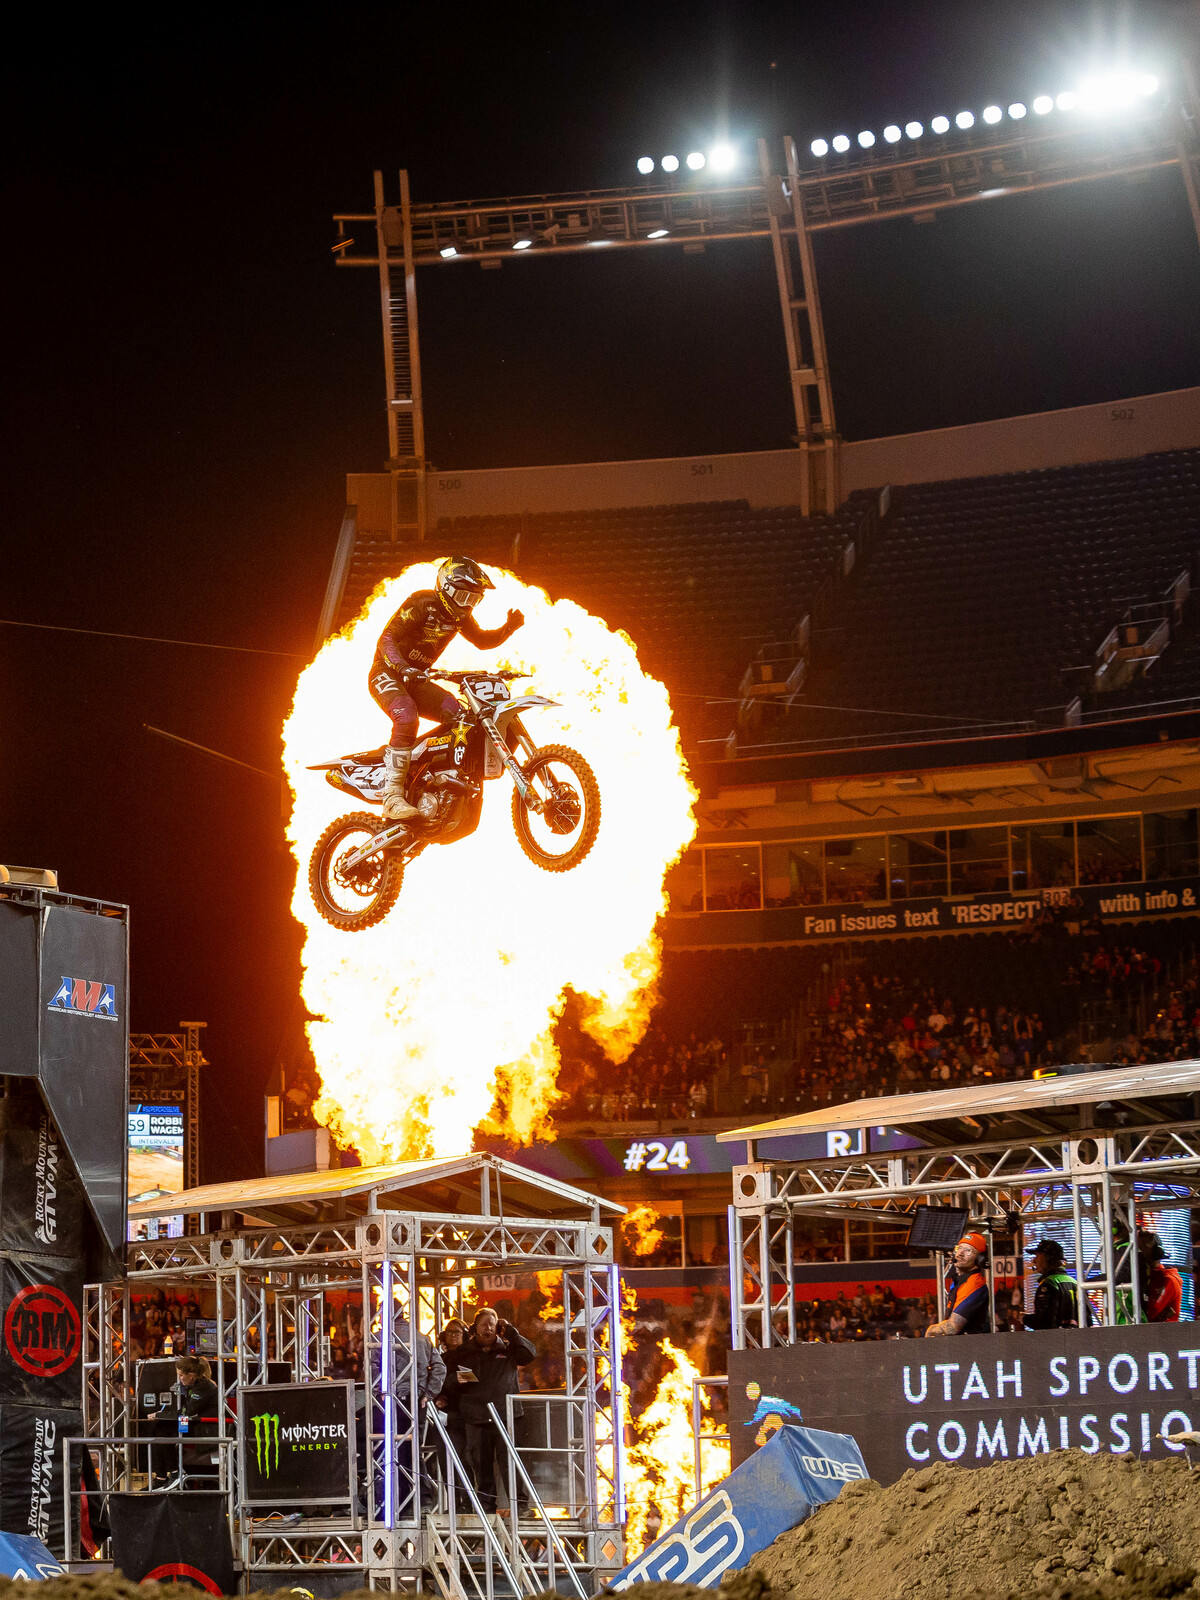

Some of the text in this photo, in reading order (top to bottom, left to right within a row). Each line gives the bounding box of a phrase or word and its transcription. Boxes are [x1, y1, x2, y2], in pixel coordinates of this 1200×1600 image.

[438, 479, 462, 491] 500
[475, 681, 510, 700] 24
[350, 766, 387, 790] 24
[1100, 887, 1197, 913] with info &
[804, 900, 1041, 934] Fan issues text 'RESPECT'
[46, 975, 119, 1017] AMA
[129, 1120, 145, 1132] 59
[623, 1141, 690, 1171] #24
[35, 1181, 45, 1223] ROCKY
[18, 1309, 69, 1351] RM
[902, 1349, 1200, 1404] UTAH SPORT
[281, 1422, 348, 1442] MONSTER
[291, 1443, 338, 1452] ENERGY
[27, 1417, 45, 1529] ROCKY MOUNTAIN
[613, 1489, 745, 1593] PS
